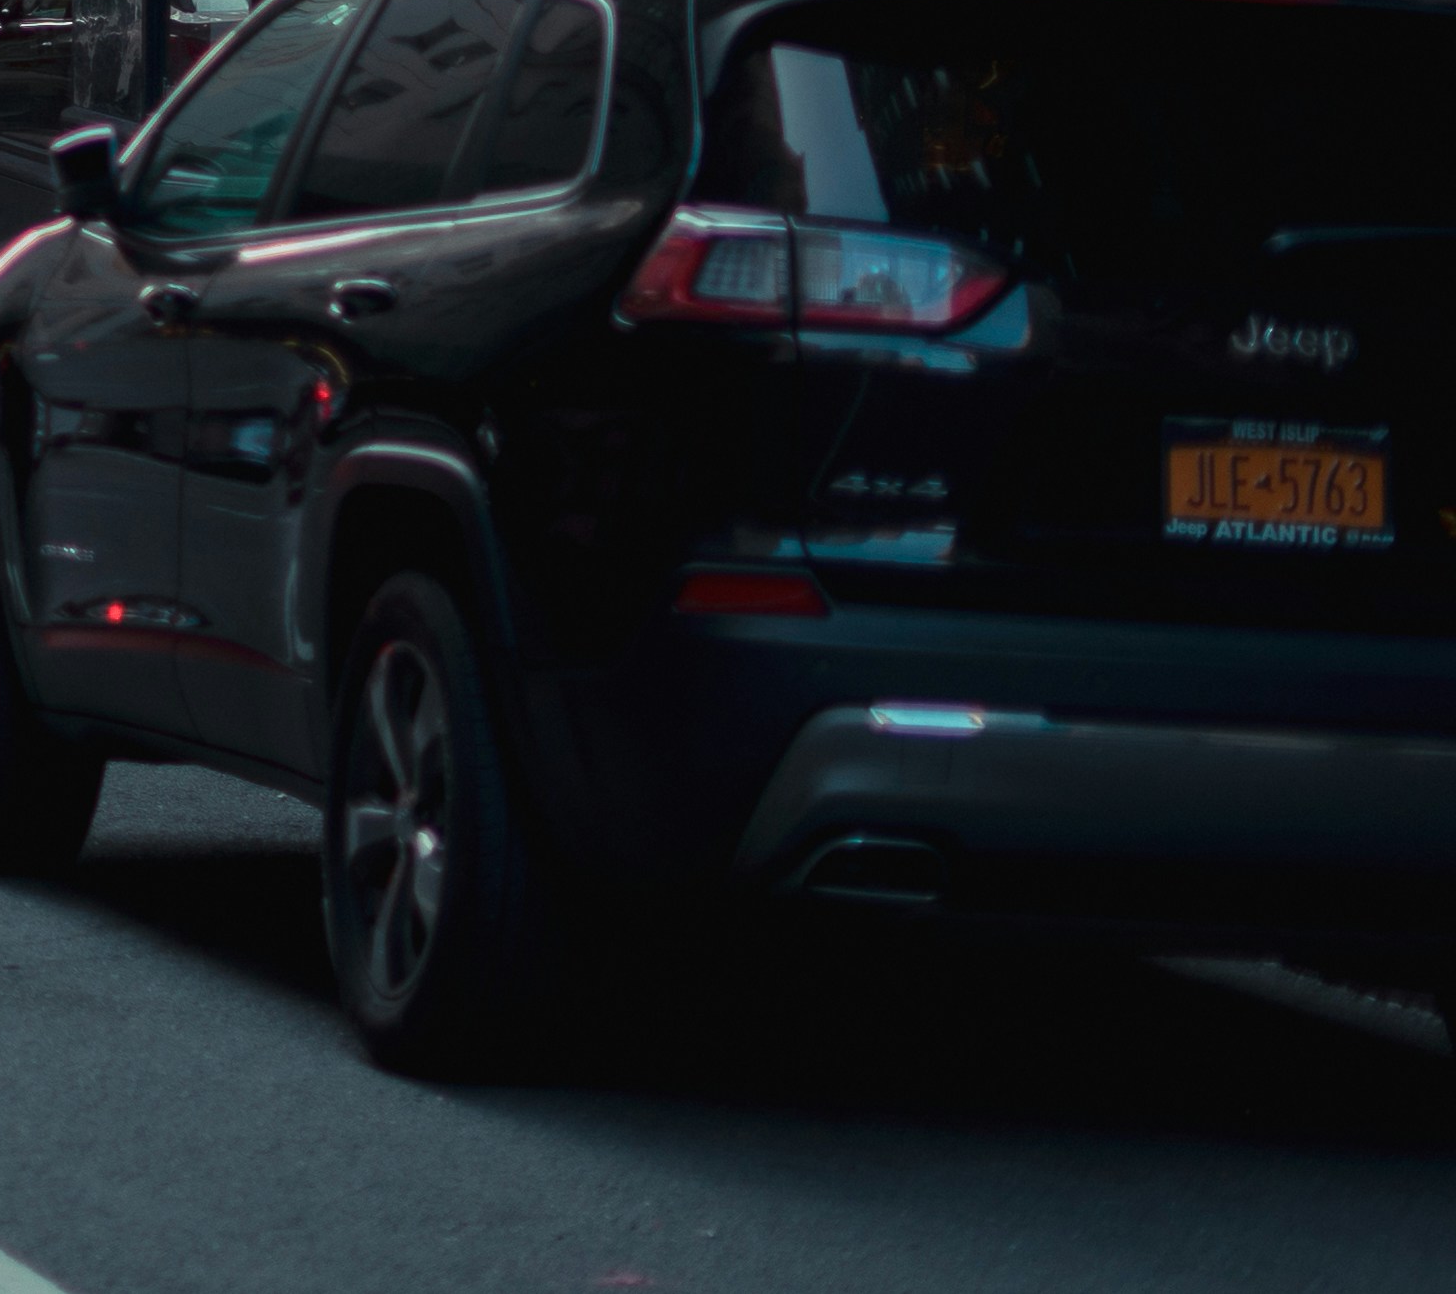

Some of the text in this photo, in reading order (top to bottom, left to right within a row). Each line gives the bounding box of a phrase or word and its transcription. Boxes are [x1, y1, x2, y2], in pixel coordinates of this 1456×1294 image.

[1227, 311, 1358, 373] Jeep
[1232, 417, 1322, 443] WEST ISLIP
[1187, 451, 1369, 517] JLE 5763
[1164, 517, 1209, 538] Jeep
[1215, 520, 1339, 546] ATLANTIC
